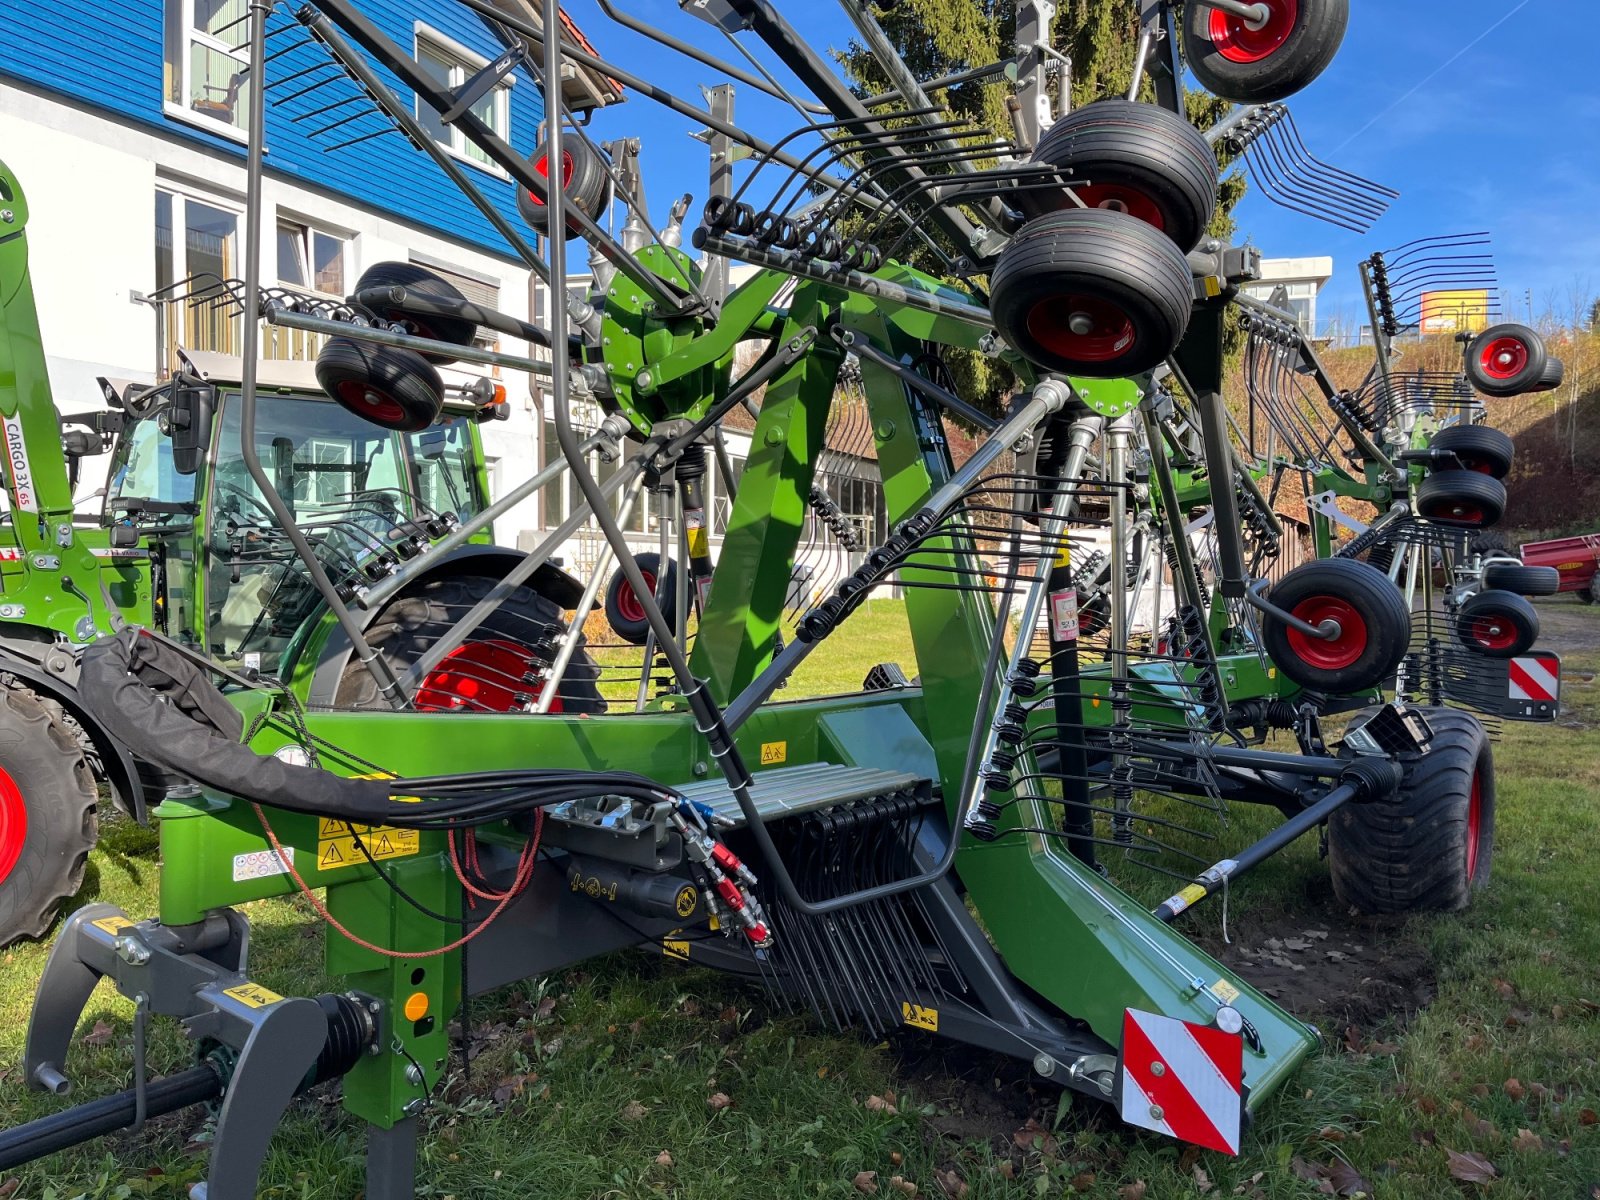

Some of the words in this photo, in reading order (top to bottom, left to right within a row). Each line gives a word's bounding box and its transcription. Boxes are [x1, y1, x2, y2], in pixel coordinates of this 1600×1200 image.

[7, 423, 26, 470] CARGO
[16, 473, 30, 489] 3X
[19, 493, 30, 505] 65
